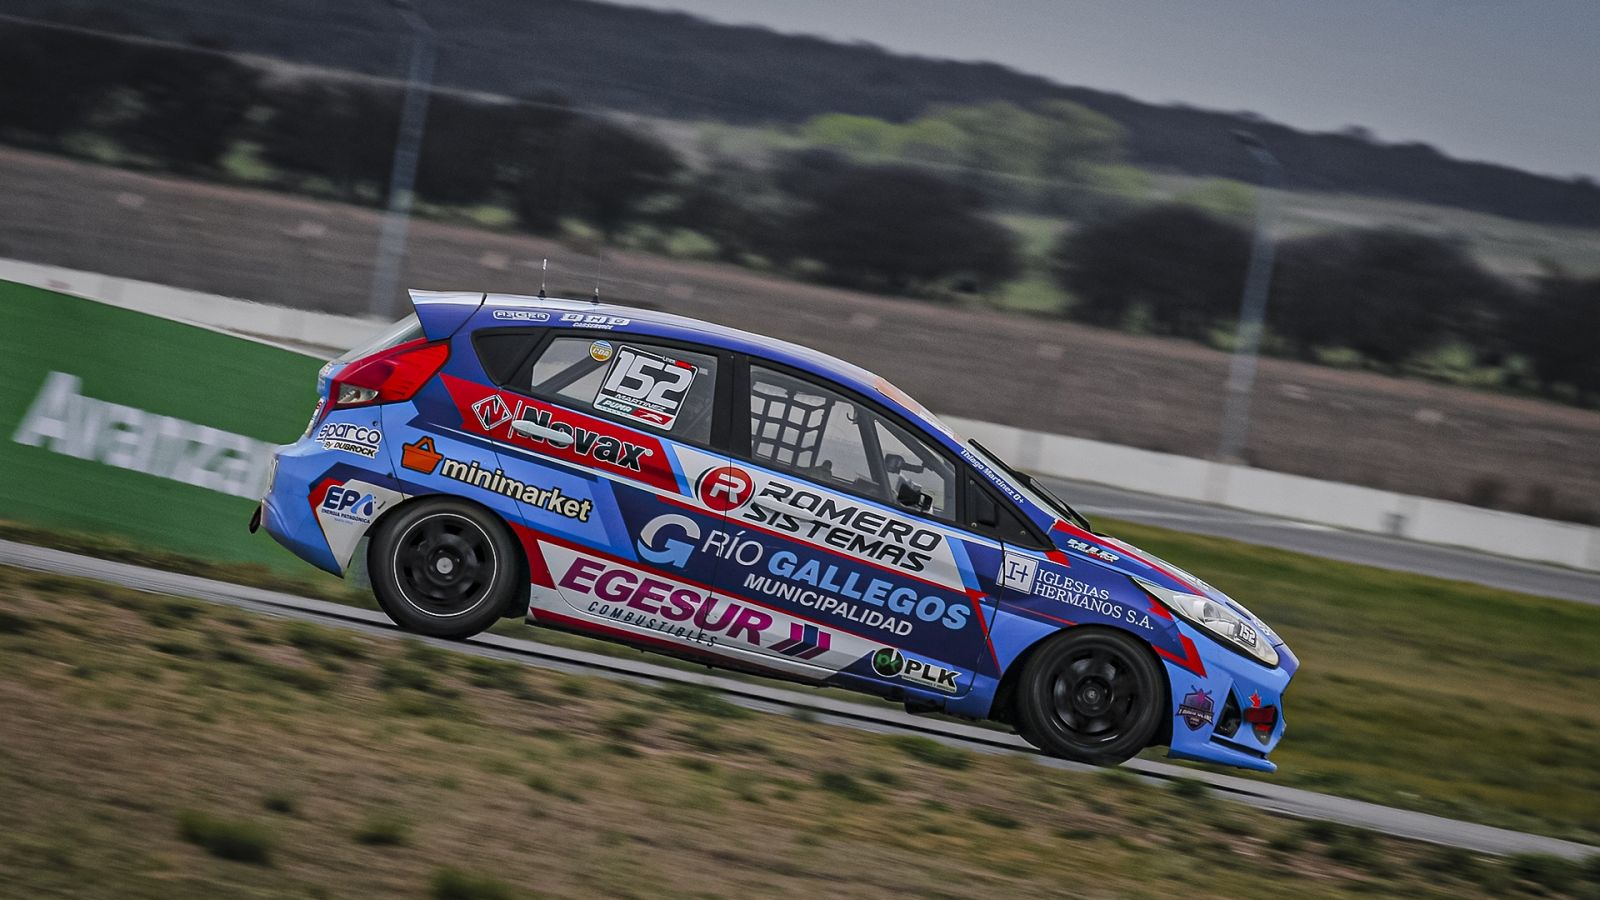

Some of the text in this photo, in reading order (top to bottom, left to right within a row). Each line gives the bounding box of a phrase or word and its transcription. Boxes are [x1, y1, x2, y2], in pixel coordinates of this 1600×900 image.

[604, 350, 693, 410] 152
[615, 393, 666, 412] MARTINEZ
[602, 399, 632, 413] PUMA
[318, 423, 381, 444] sparco
[333, 442, 376, 457] DUBROCK
[961, 449, 984, 469] Thiago
[440, 456, 593, 523] minimarket
[743, 501, 932, 573] SISTEMAS
[758, 480, 942, 552] ROMERO
[558, 557, 773, 646] EGESUR
[701, 529, 971, 630] RÍO GALLEGOS
[1037, 568, 1110, 600] IGLESIAS
[587, 600, 718, 648] COMBUSTIBLES
[743, 573, 913, 637] MUNICIPALIDAD
[1034, 584, 1154, 630] HERMANOS S.A.
[1239, 622, 1256, 645] 152
[904, 659, 962, 688] PLK
